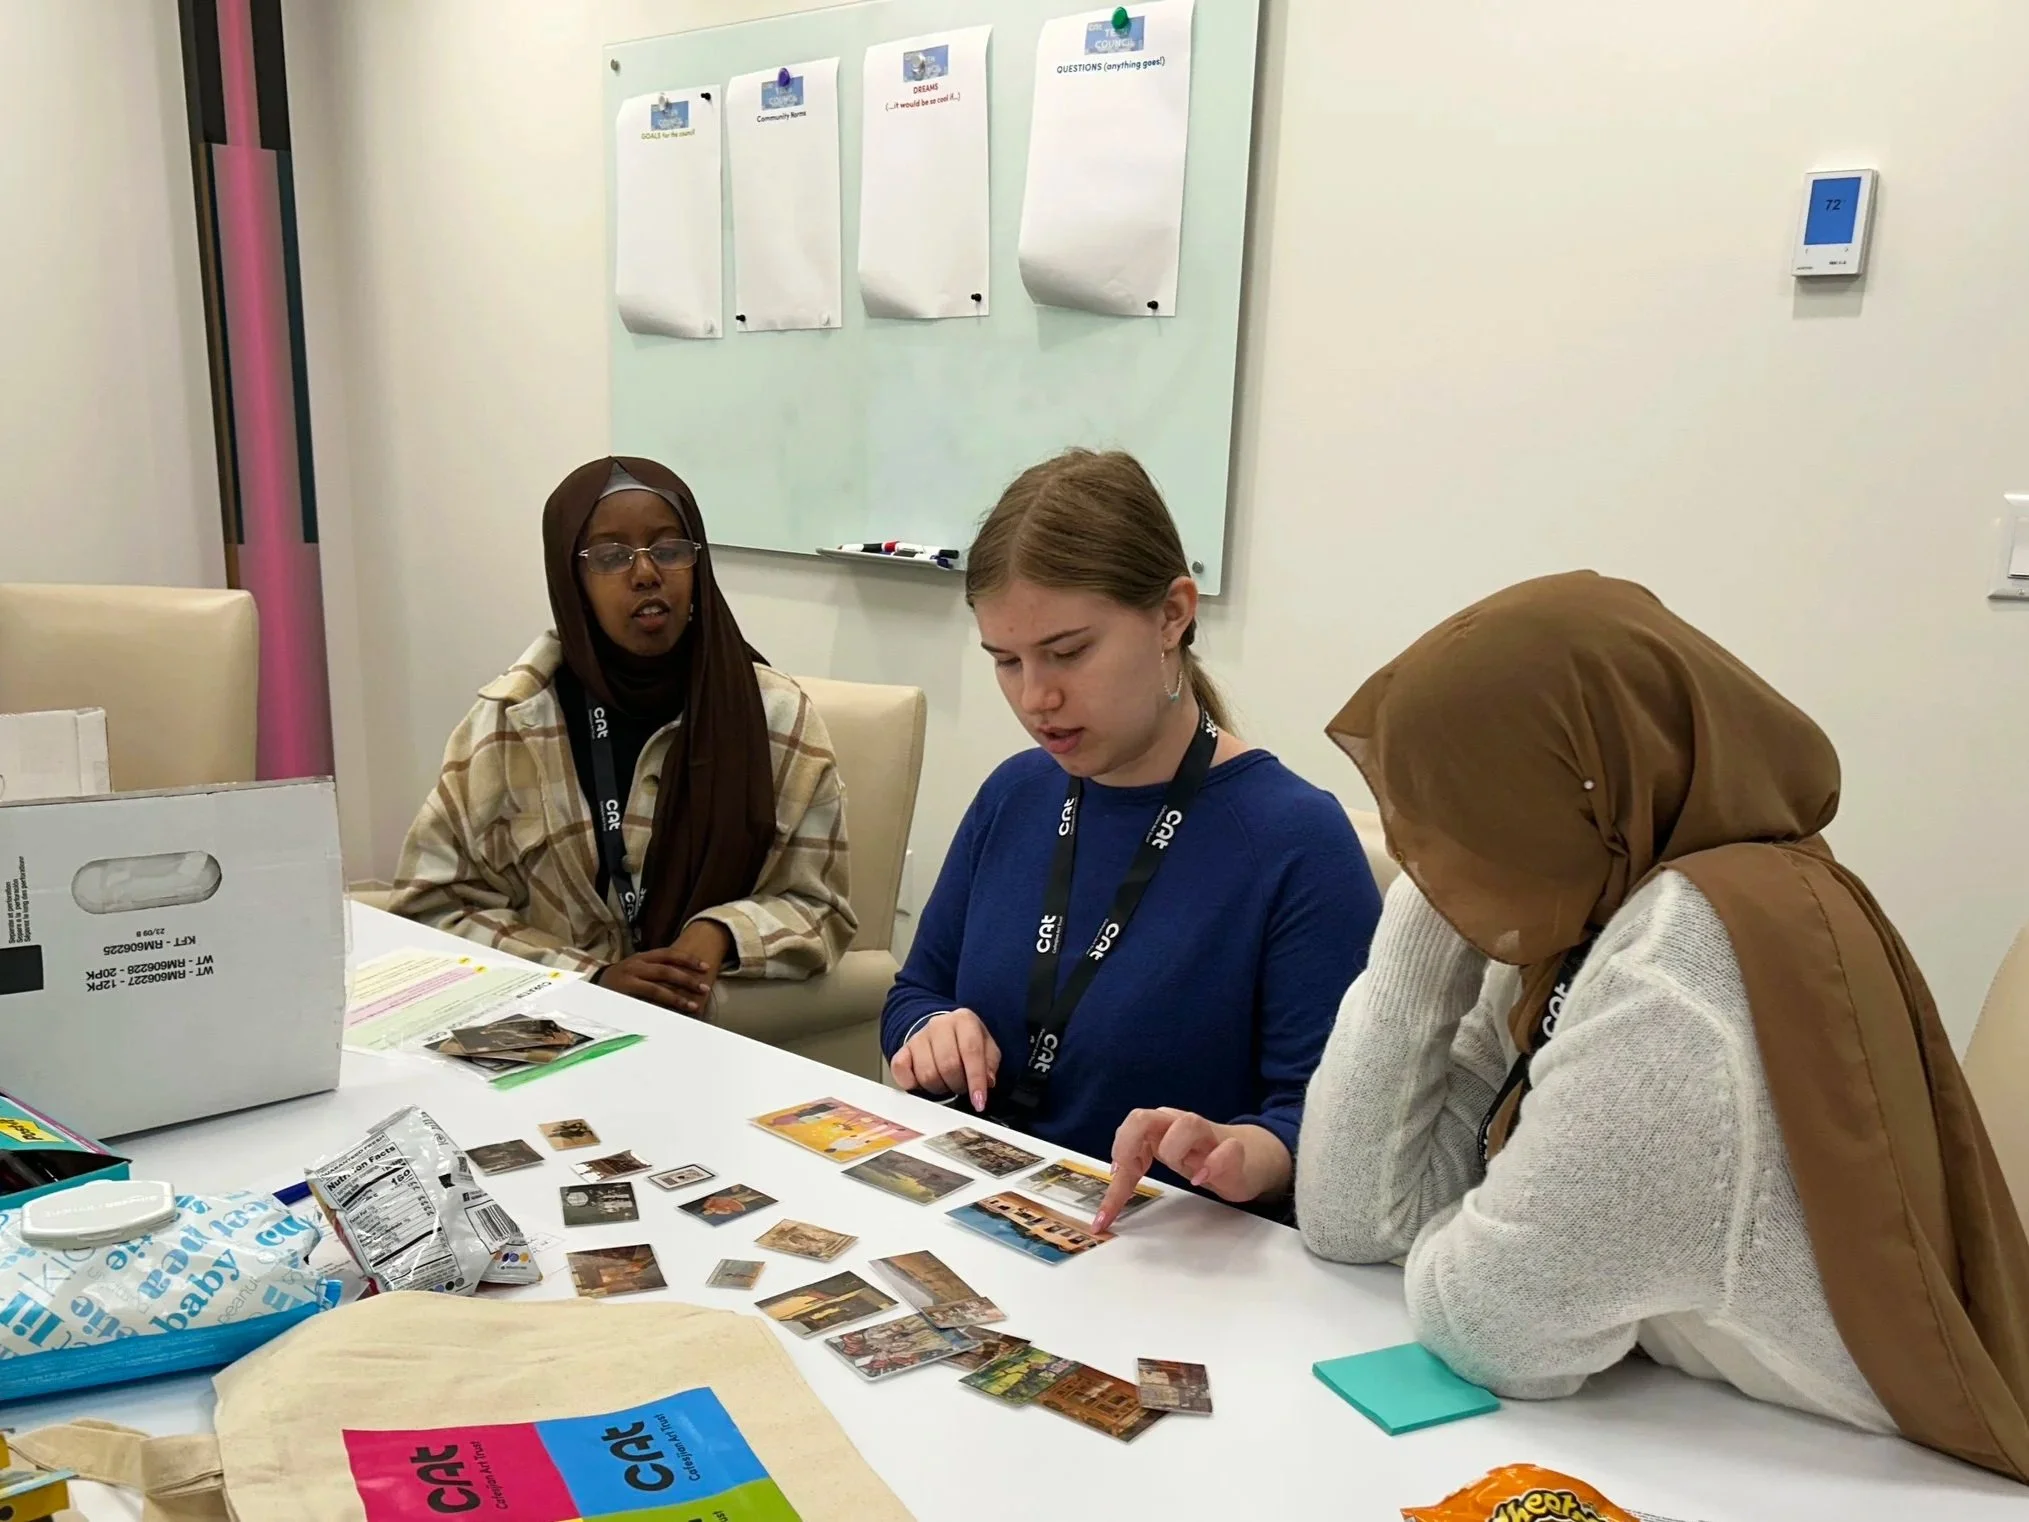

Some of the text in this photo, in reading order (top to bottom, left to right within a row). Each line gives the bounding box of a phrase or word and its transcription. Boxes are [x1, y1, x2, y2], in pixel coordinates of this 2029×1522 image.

[1056, 56, 1165, 74] QUESTIONS (anything goes!)
[913, 83, 939, 94] DREAMS
[900, 100, 921, 108] would
[937, 94, 949, 104] cool
[757, 113, 790, 123] Community
[641, 132, 661, 140] GOALS
[143, 928, 165, 937] 23/09
[103, 939, 164, 956] RM606225
[173, 935, 196, 947] KFT
[127, 958, 186, 975] RM606228
[195, 955, 214, 966] WT
[86, 967, 117, 981] 20PK
[127, 970, 186, 986] RM606227
[196, 966, 214, 977] WT
[86, 979, 117, 992] 12PK
[369, 1146, 395, 1163] Facts
[391, 1169, 411, 1186] 160
[148, 1248, 239, 1333] baby
[653, 1413, 701, 1482] Cafesjian Art Trust
[470, 1441, 509, 1510] Cafesjian Art Trust
